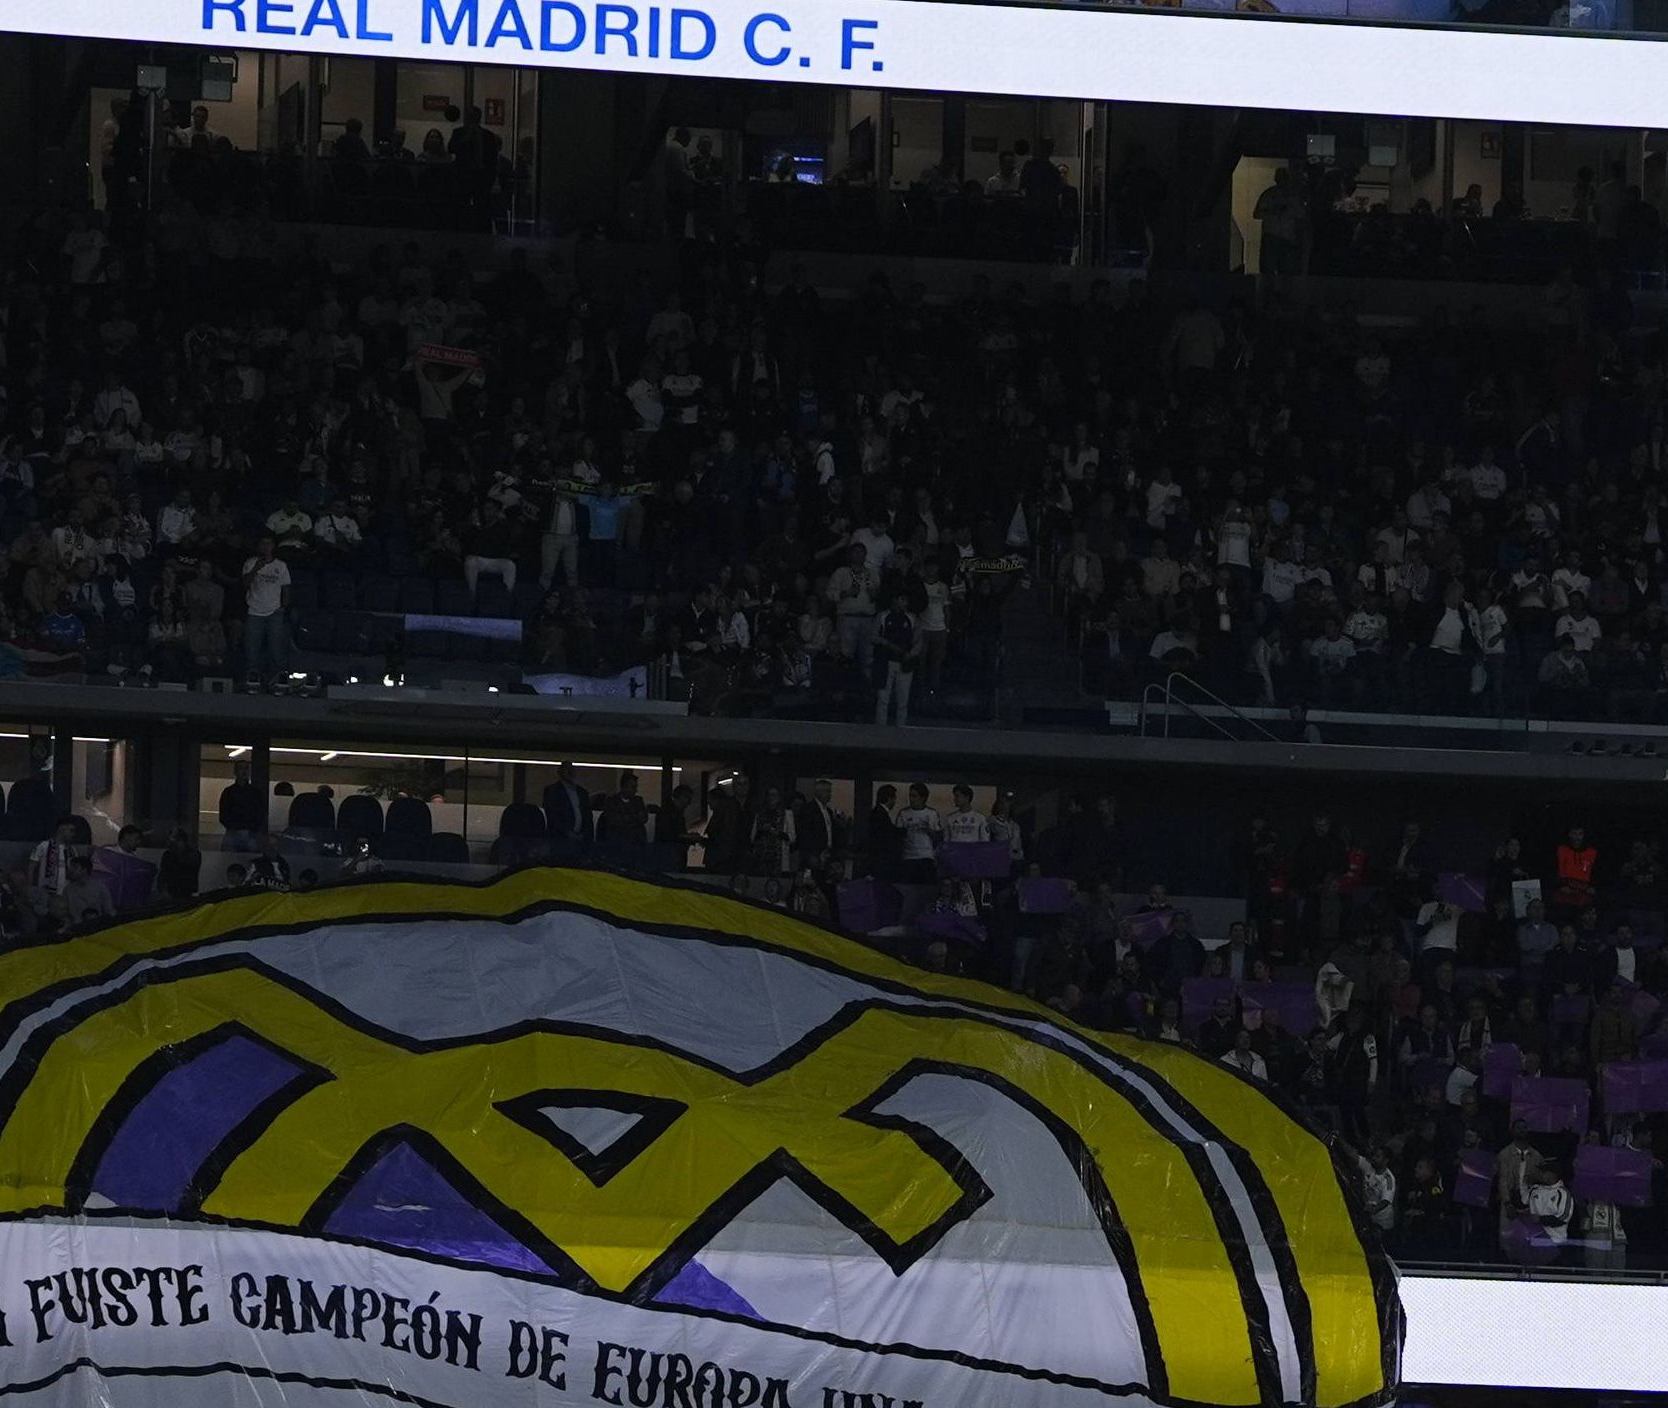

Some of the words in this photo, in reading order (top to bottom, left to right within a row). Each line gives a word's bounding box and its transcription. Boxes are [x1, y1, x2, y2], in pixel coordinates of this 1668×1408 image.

[202, 0, 392, 42] REAL
[421, 0, 717, 62] MADRID
[743, 13, 809, 68] C.
[841, 19, 885, 72] F.
[24, 1264, 209, 1344] FUISTE
[229, 1270, 483, 1372] CAMPEÓN
[505, 1319, 571, 1392] DE
